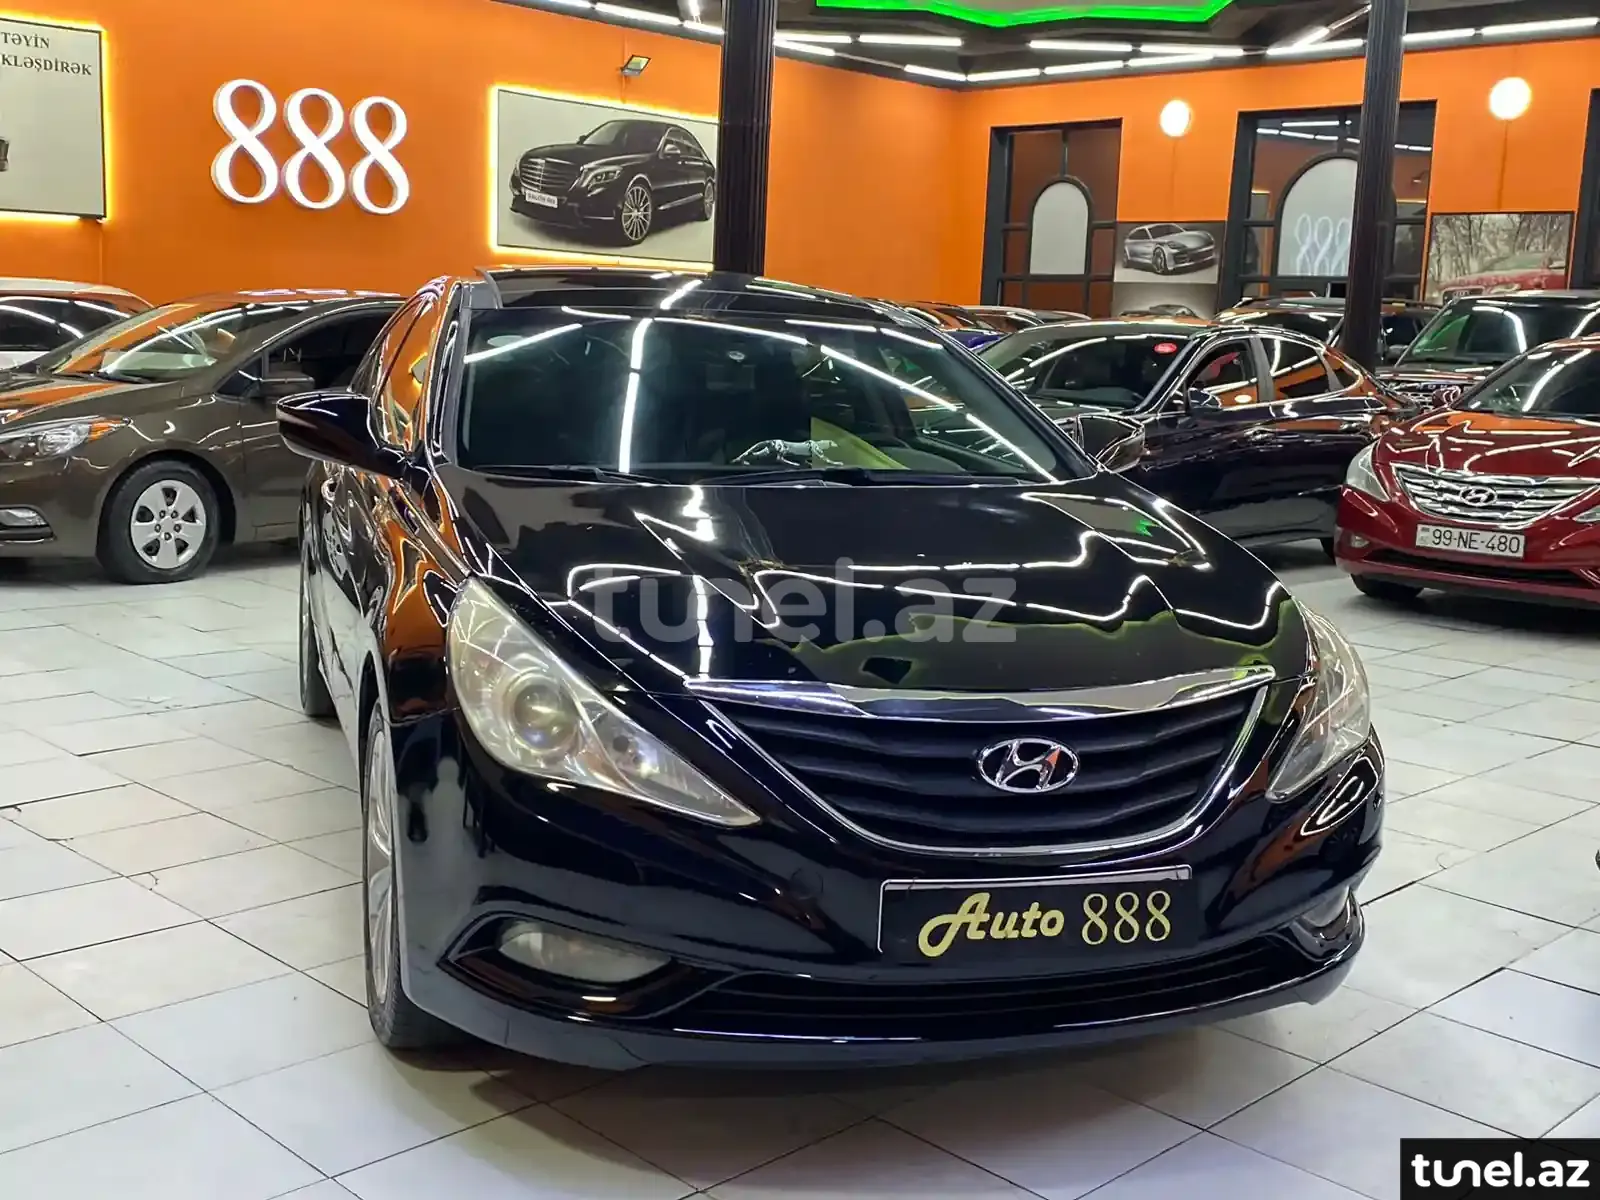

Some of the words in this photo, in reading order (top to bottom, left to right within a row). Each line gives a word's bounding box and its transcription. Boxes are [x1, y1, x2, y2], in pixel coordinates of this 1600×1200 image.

[1, 31, 50, 49] TƏYİN
[210, 78, 411, 215] 888
[1432, 529, 1520, 554] 99-NE-480
[917, 892, 1065, 958] Auto
[1081, 890, 1172, 946] 888
